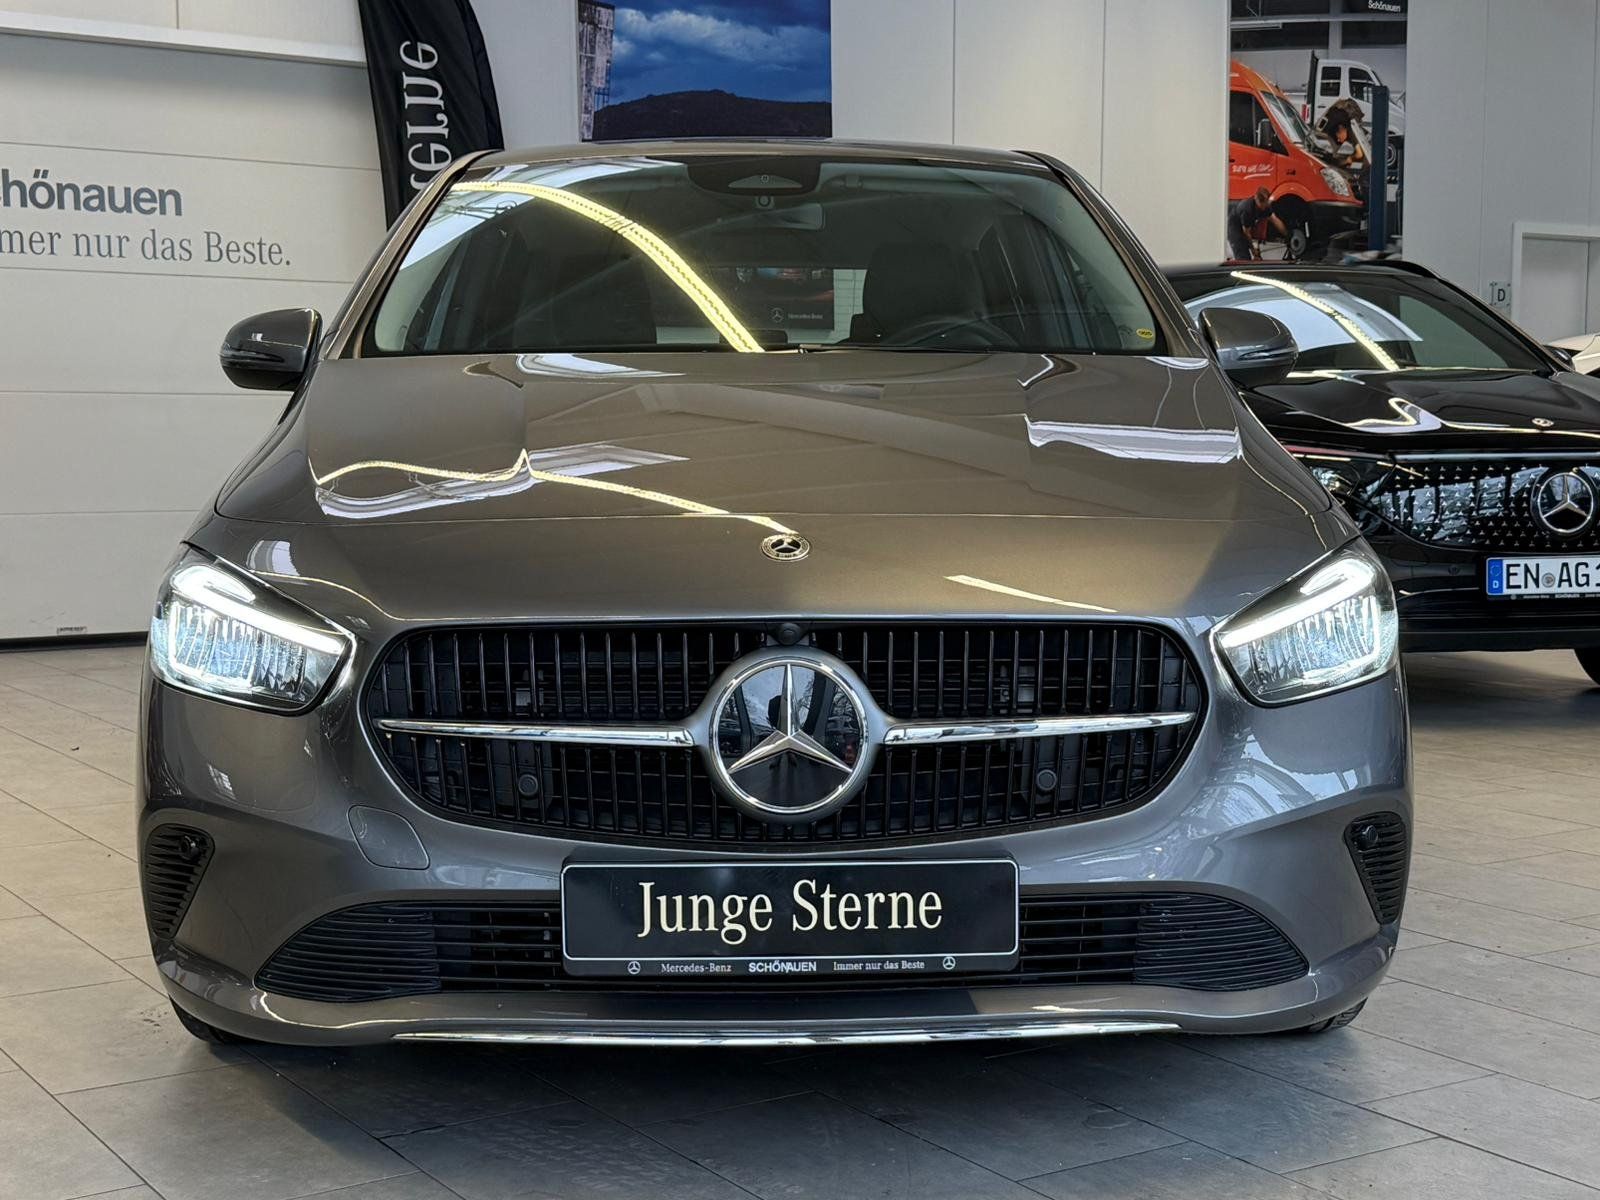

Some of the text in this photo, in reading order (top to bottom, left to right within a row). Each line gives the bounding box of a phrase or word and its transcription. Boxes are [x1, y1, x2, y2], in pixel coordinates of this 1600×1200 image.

[0, 168, 182, 216] hönauen
[73, 232, 130, 259] nur
[141, 229, 193, 262] das
[204, 231, 291, 266] Beste.
[1497, 288, 1506, 301] D
[1506, 563, 1540, 589] EN
[637, 879, 942, 945] Junge Sterne
[661, 960, 925, 973] Mercedes-Benz SCHÖNAUEN Immer nur das Beste
